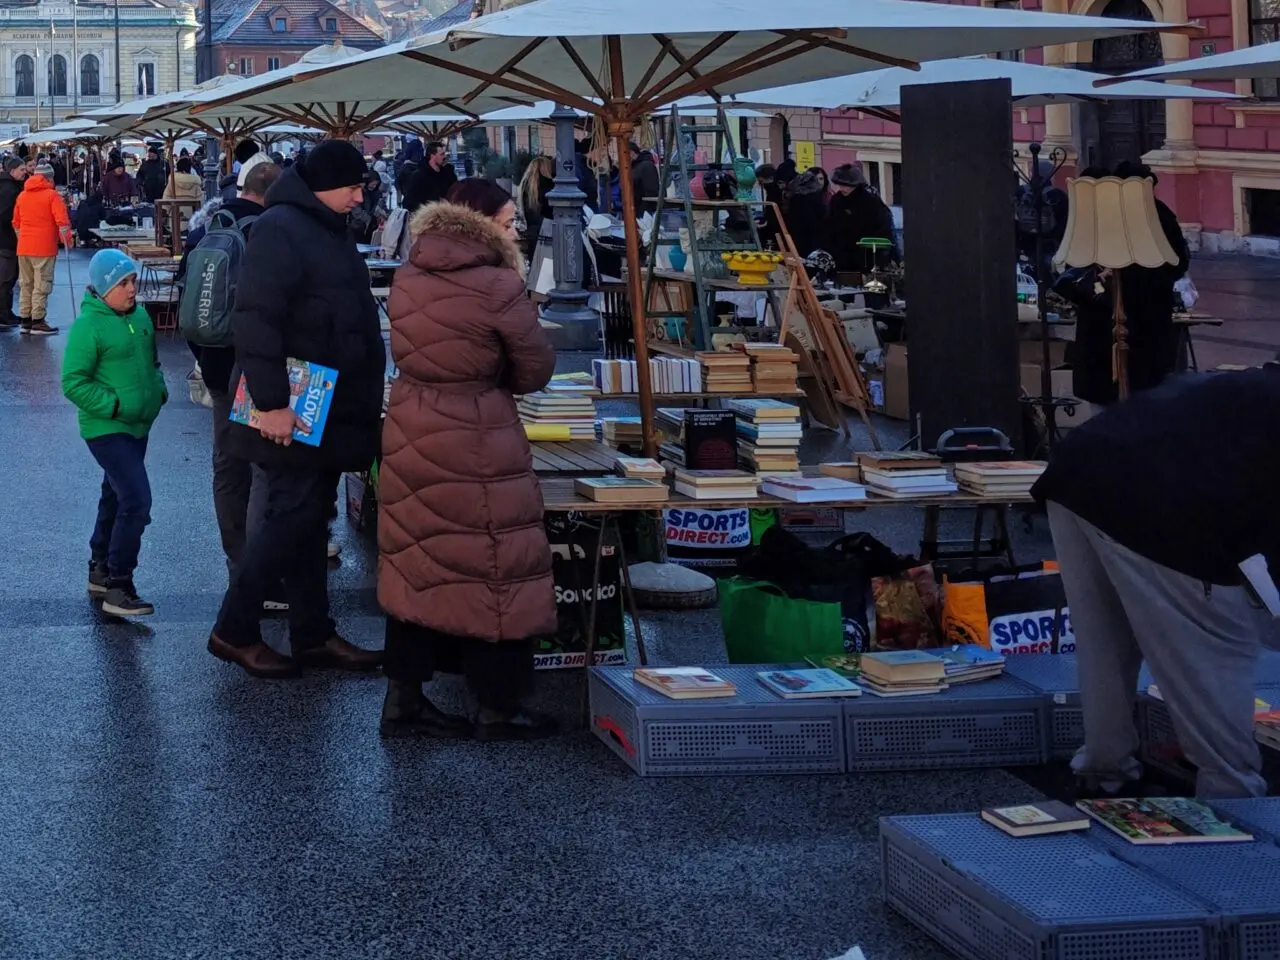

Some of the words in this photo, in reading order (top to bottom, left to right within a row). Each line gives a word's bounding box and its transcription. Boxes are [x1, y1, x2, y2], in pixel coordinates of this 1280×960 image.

[667, 509, 746, 530] SPORTS
[666, 527, 748, 544] DIRECT.COM
[994, 614, 1073, 645] SPORT
